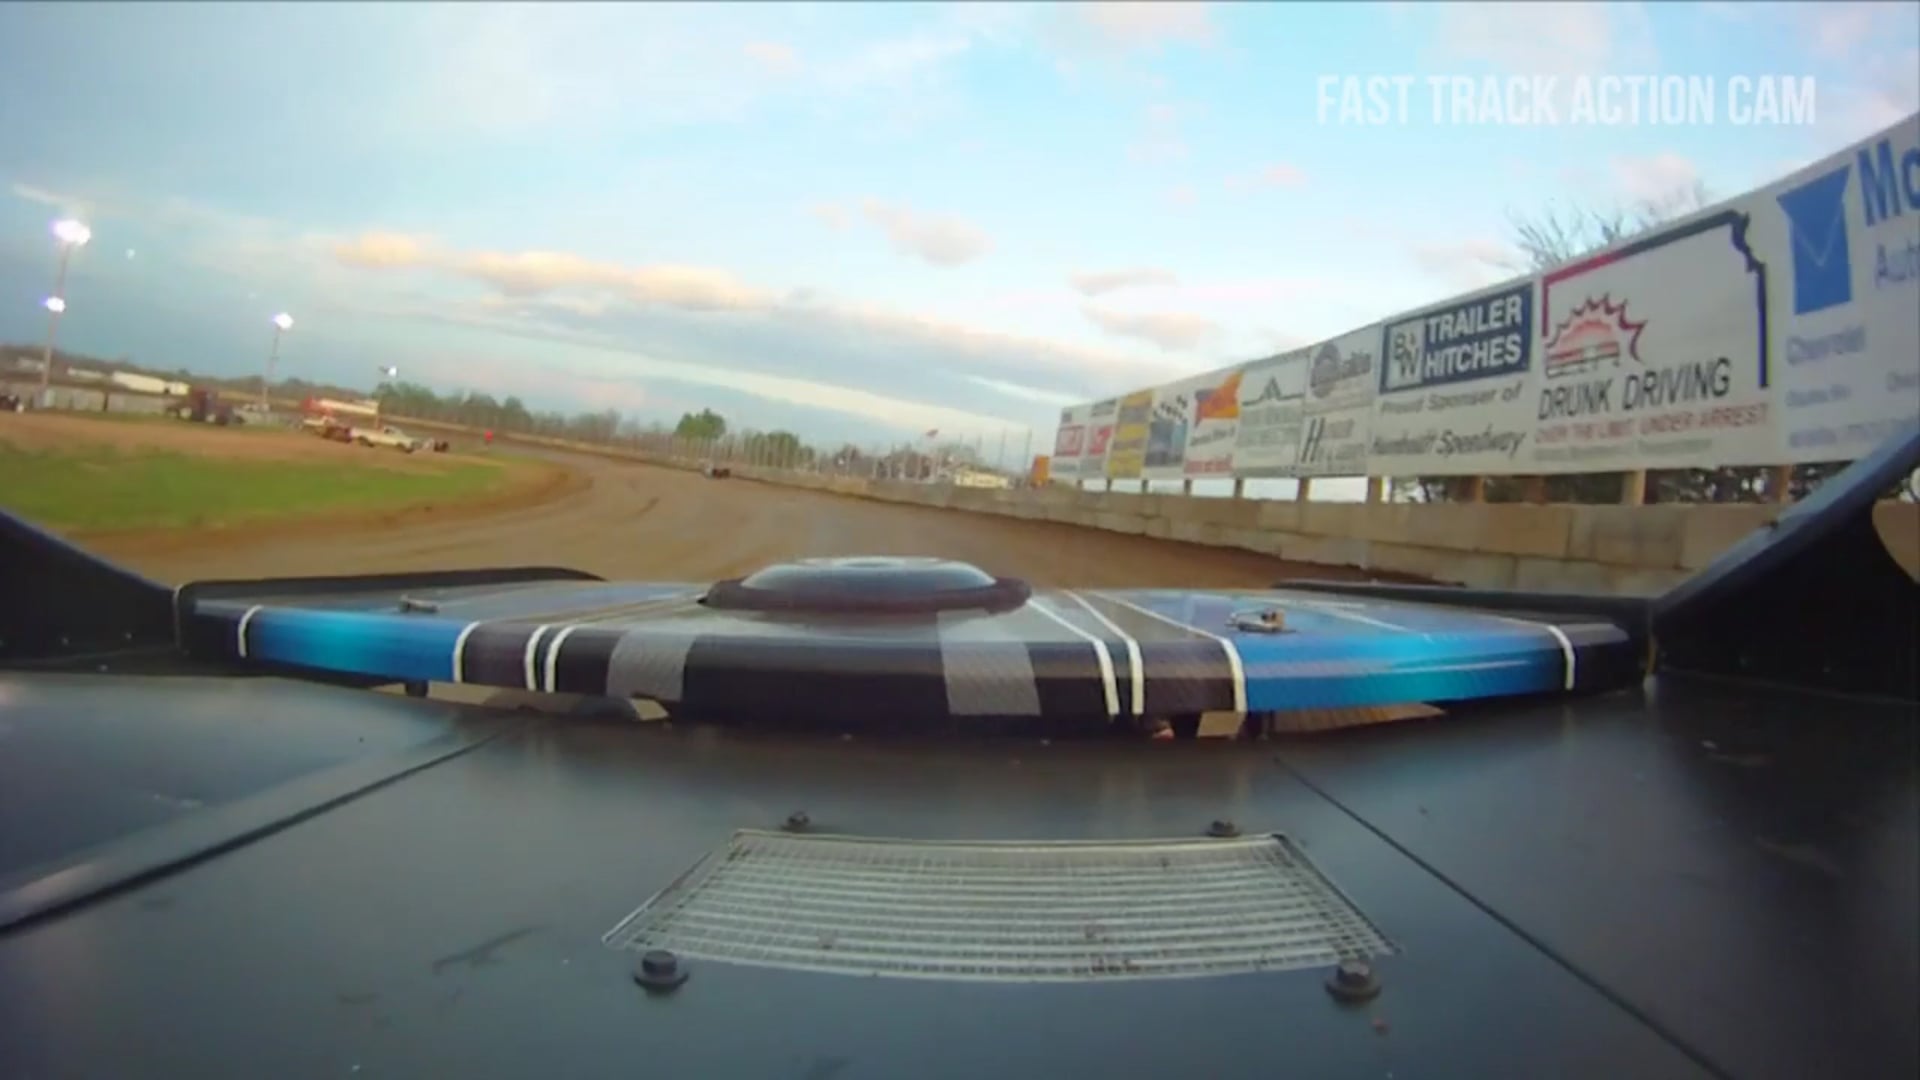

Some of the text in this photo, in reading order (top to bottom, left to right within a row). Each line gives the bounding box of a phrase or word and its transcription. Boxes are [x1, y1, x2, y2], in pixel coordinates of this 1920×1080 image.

[1426, 295, 1523, 344] TRAILER
[1424, 333, 1522, 379] HITCHES
[1537, 378, 1614, 421] DRUNK
[1622, 357, 1732, 411] DRIVING
[1638, 411, 1695, 435] UNDER
[1698, 402, 1769, 428] ARREST
